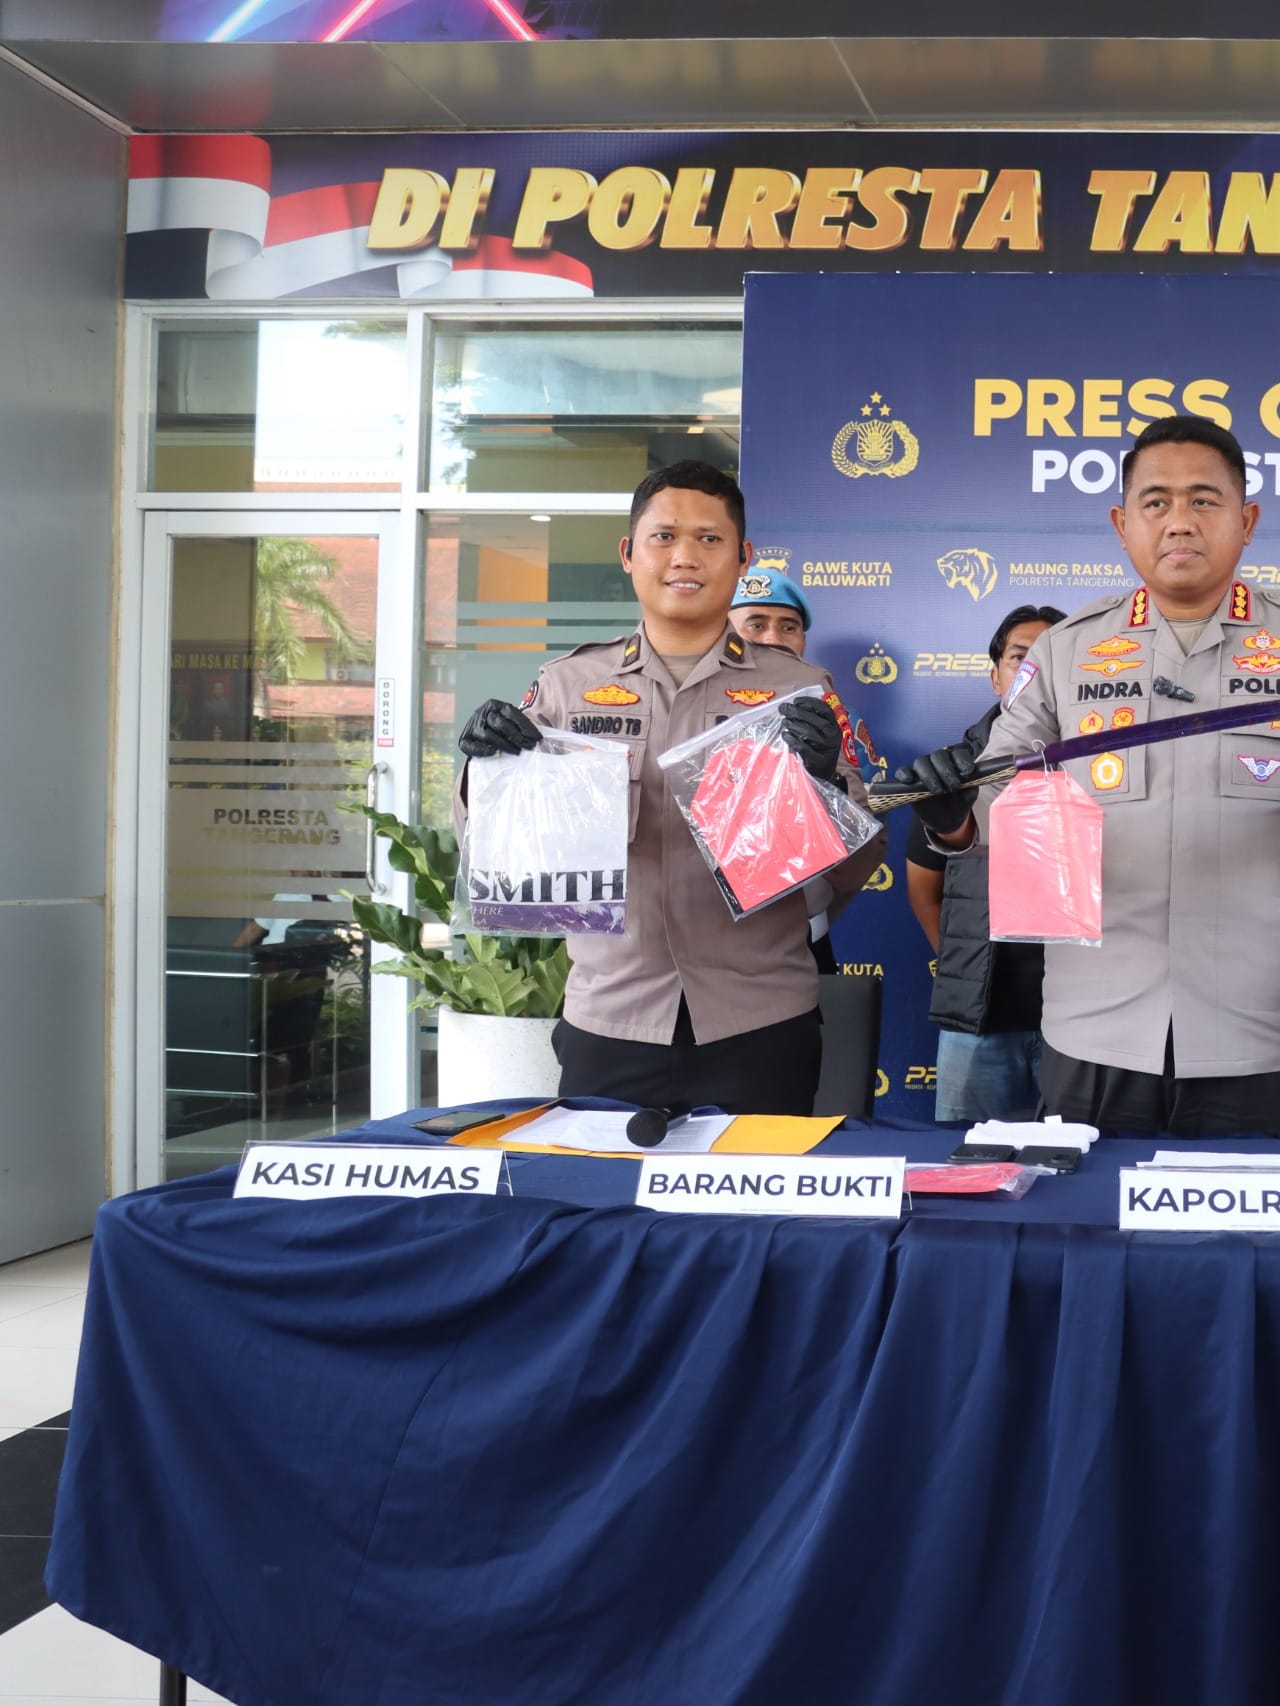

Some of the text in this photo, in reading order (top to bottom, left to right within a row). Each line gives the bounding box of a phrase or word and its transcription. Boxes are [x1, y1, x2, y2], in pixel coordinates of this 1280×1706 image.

[367, 167, 495, 250] DI
[511, 166, 1045, 252] POLRESTA
[973, 378, 1233, 438] PRESS
[802, 561, 893, 575] GAWE KUTA
[1009, 562, 1124, 577] MAUNG RAKSA
[802, 574, 891, 587] BALUWARTI
[1009, 576, 1135, 588] POLRESTA TANGERANG
[1077, 681, 1144, 702] INDRA
[382, 681, 390, 736] DORONG
[570, 716, 642, 736] SANDRO TB
[213, 808, 329, 826] POLRESTA
[201, 826, 341, 846] TANGERANG
[470, 869, 626, 903] SMITH
[843, 963, 884, 977] KUTA
[251, 1161, 480, 1191] KASI HUMAS
[647, 1172, 892, 1198] BARANG BUKTI
